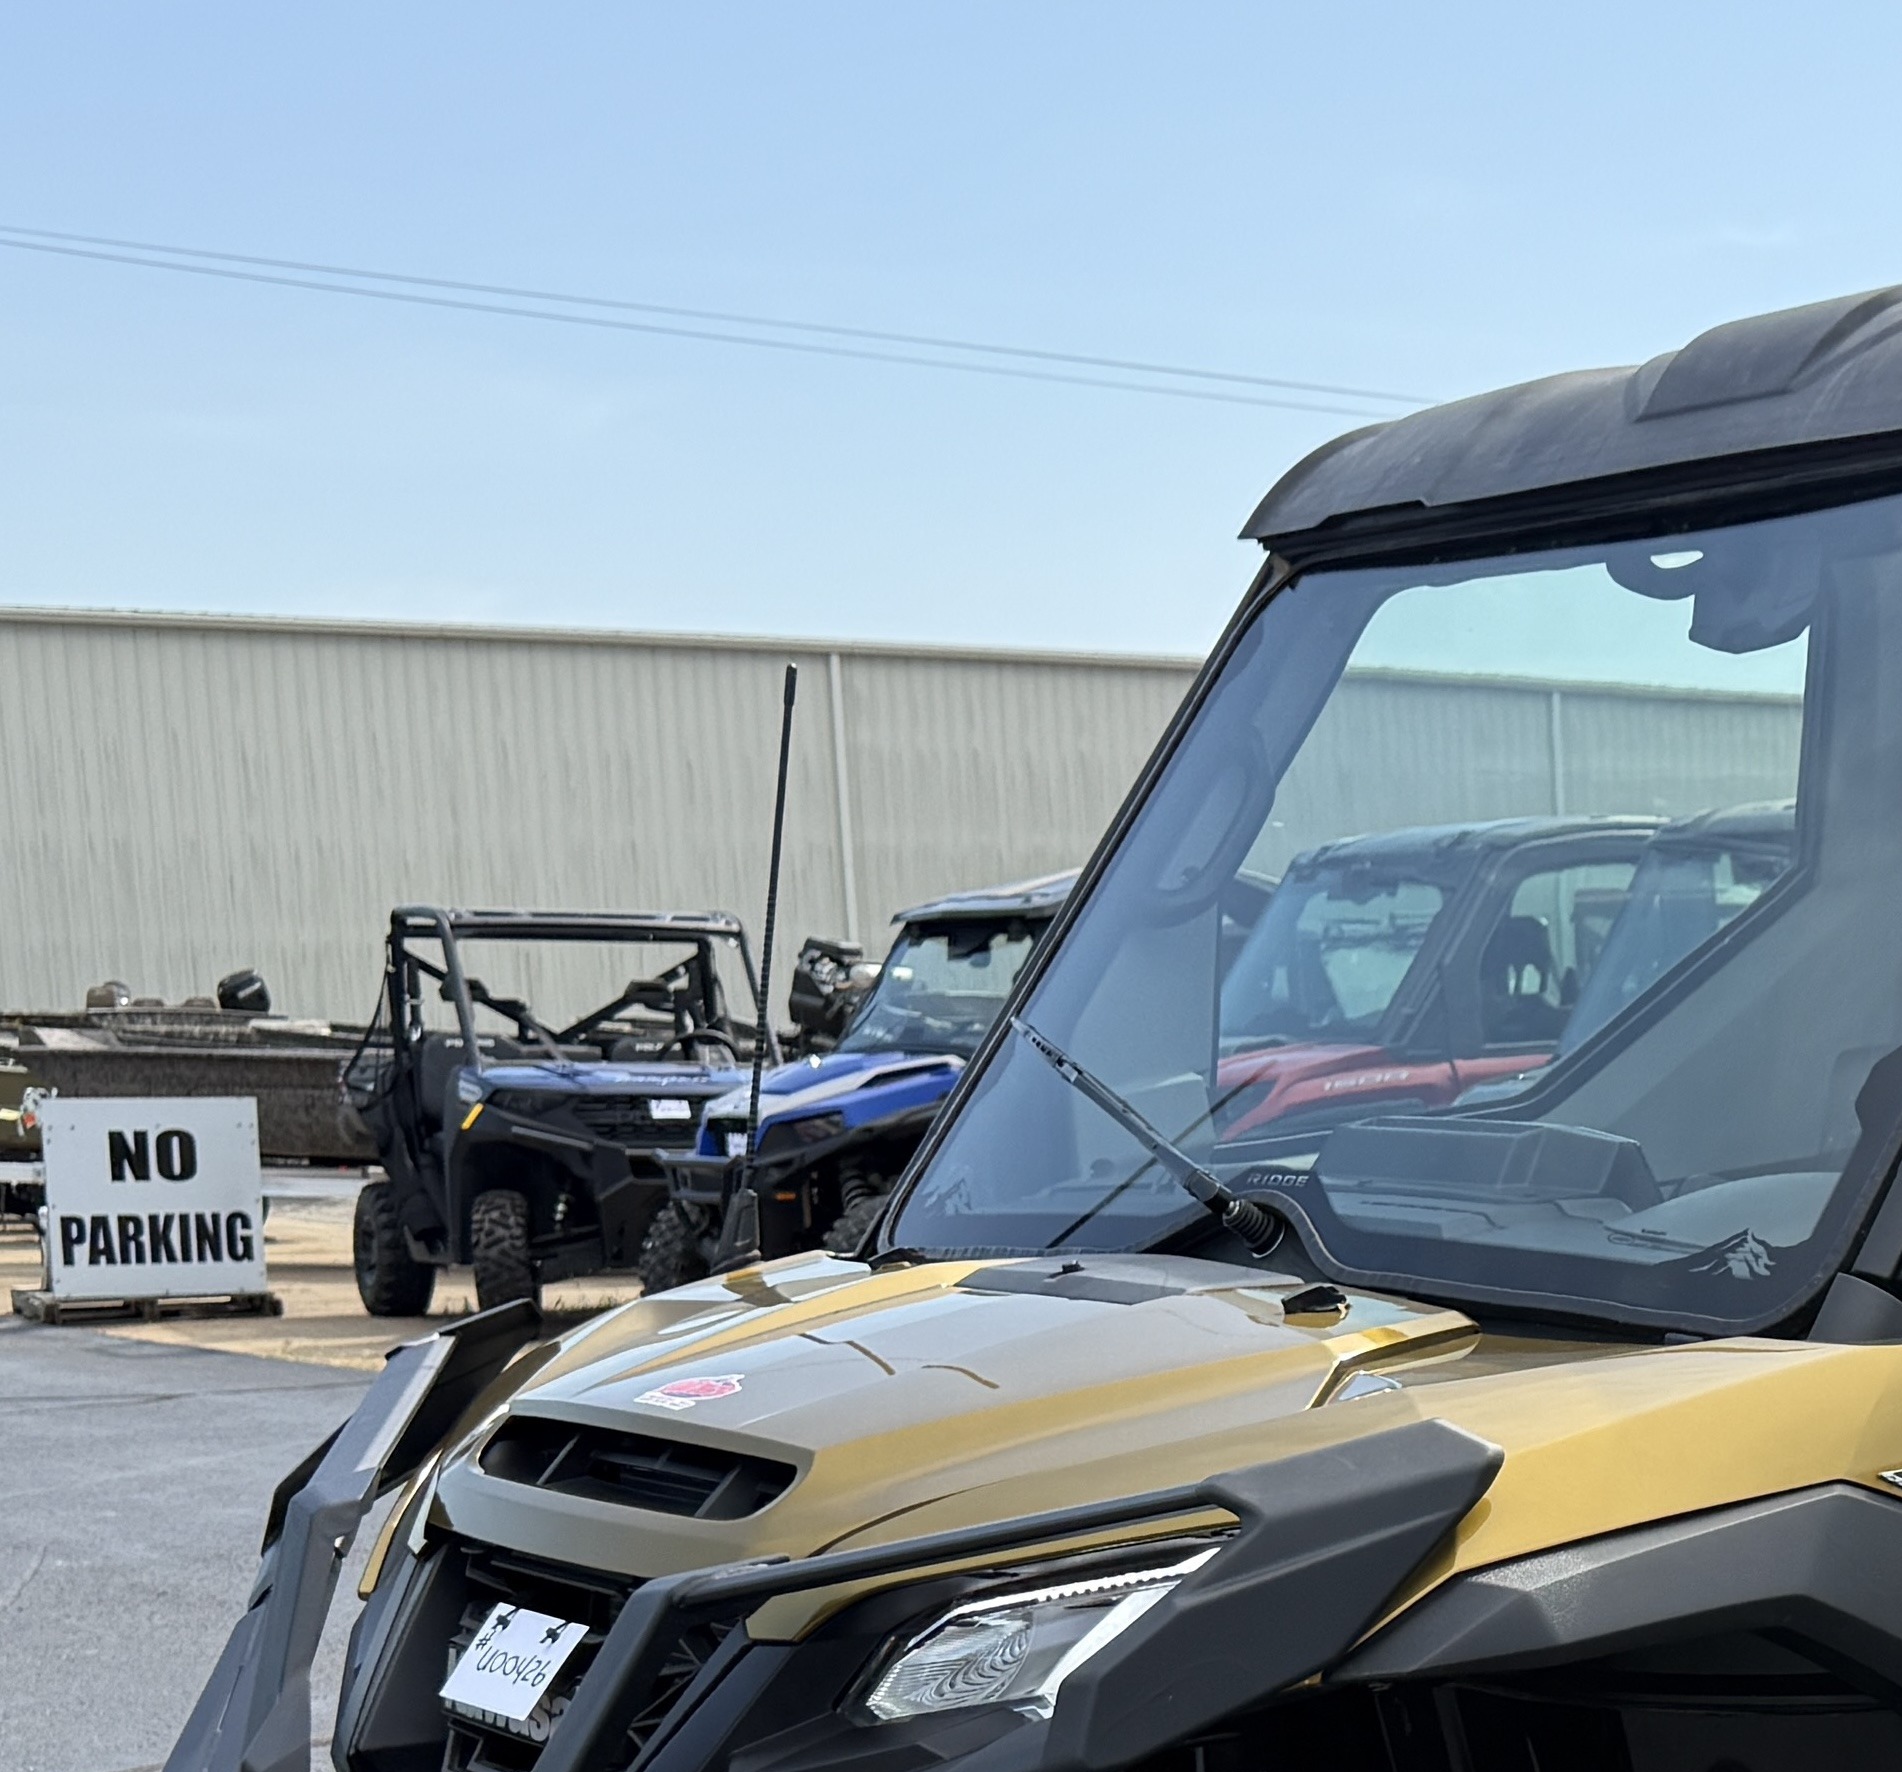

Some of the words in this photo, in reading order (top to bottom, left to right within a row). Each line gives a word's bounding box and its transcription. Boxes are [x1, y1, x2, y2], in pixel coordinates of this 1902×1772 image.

[107, 1127, 198, 1182] NO
[1245, 1173, 1310, 1188] RIDGE
[59, 1211, 256, 1267] PARKING
